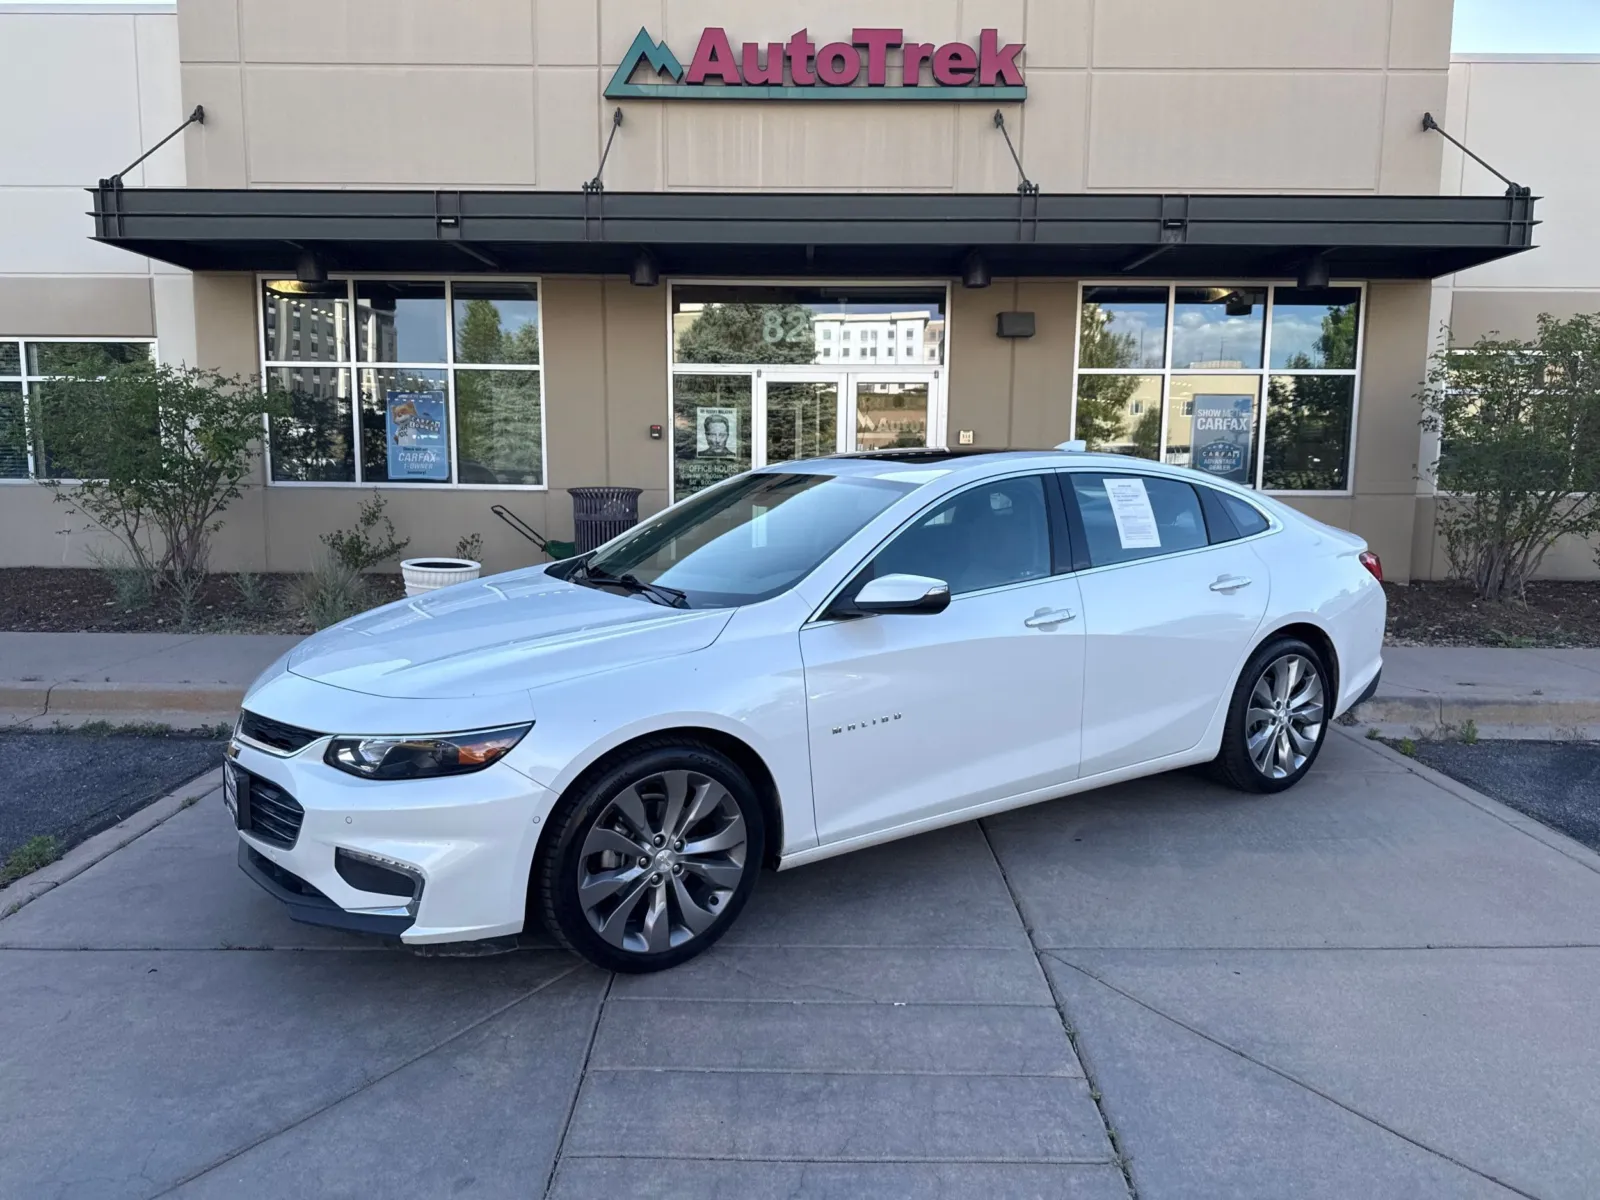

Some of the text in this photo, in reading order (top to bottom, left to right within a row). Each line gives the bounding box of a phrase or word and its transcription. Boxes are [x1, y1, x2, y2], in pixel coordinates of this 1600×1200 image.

[685, 27, 1027, 87] AutoTrek
[763, 310, 807, 342] 82
[1197, 409, 1221, 417] SHOW
[1197, 418, 1248, 430] CARFAX
[398, 452, 437, 463] CARFAX
[688, 464, 739, 473] OFFICE HOURS
